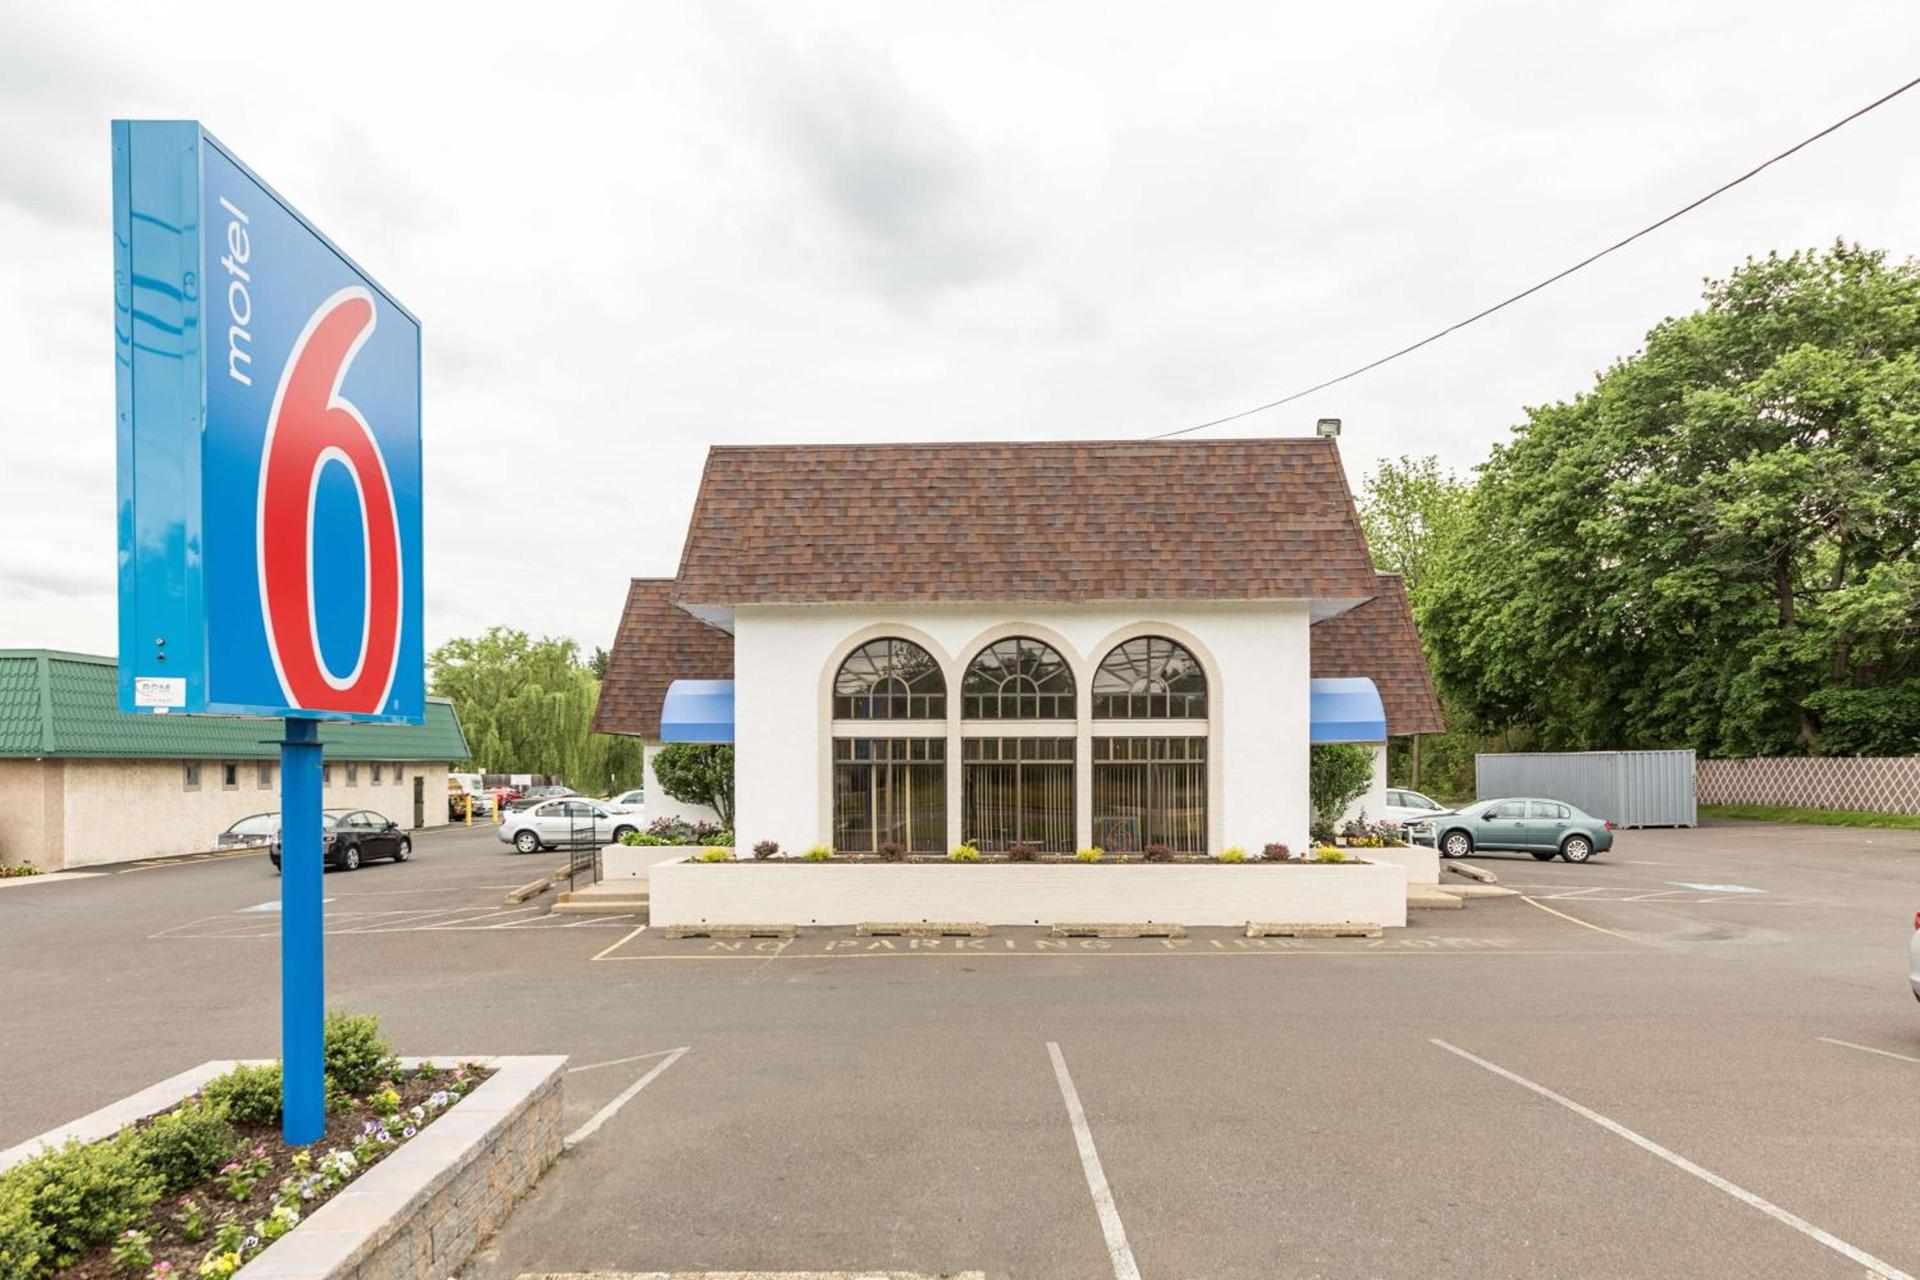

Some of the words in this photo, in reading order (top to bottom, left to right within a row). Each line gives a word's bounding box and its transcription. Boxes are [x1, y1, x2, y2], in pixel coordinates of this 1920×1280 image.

[219, 195, 252, 387] motel
[256, 286, 404, 714] 6
[708, 941, 786, 951] NO
[824, 939, 1112, 951] PARKING
[1161, 939, 1317, 949] FIRE
